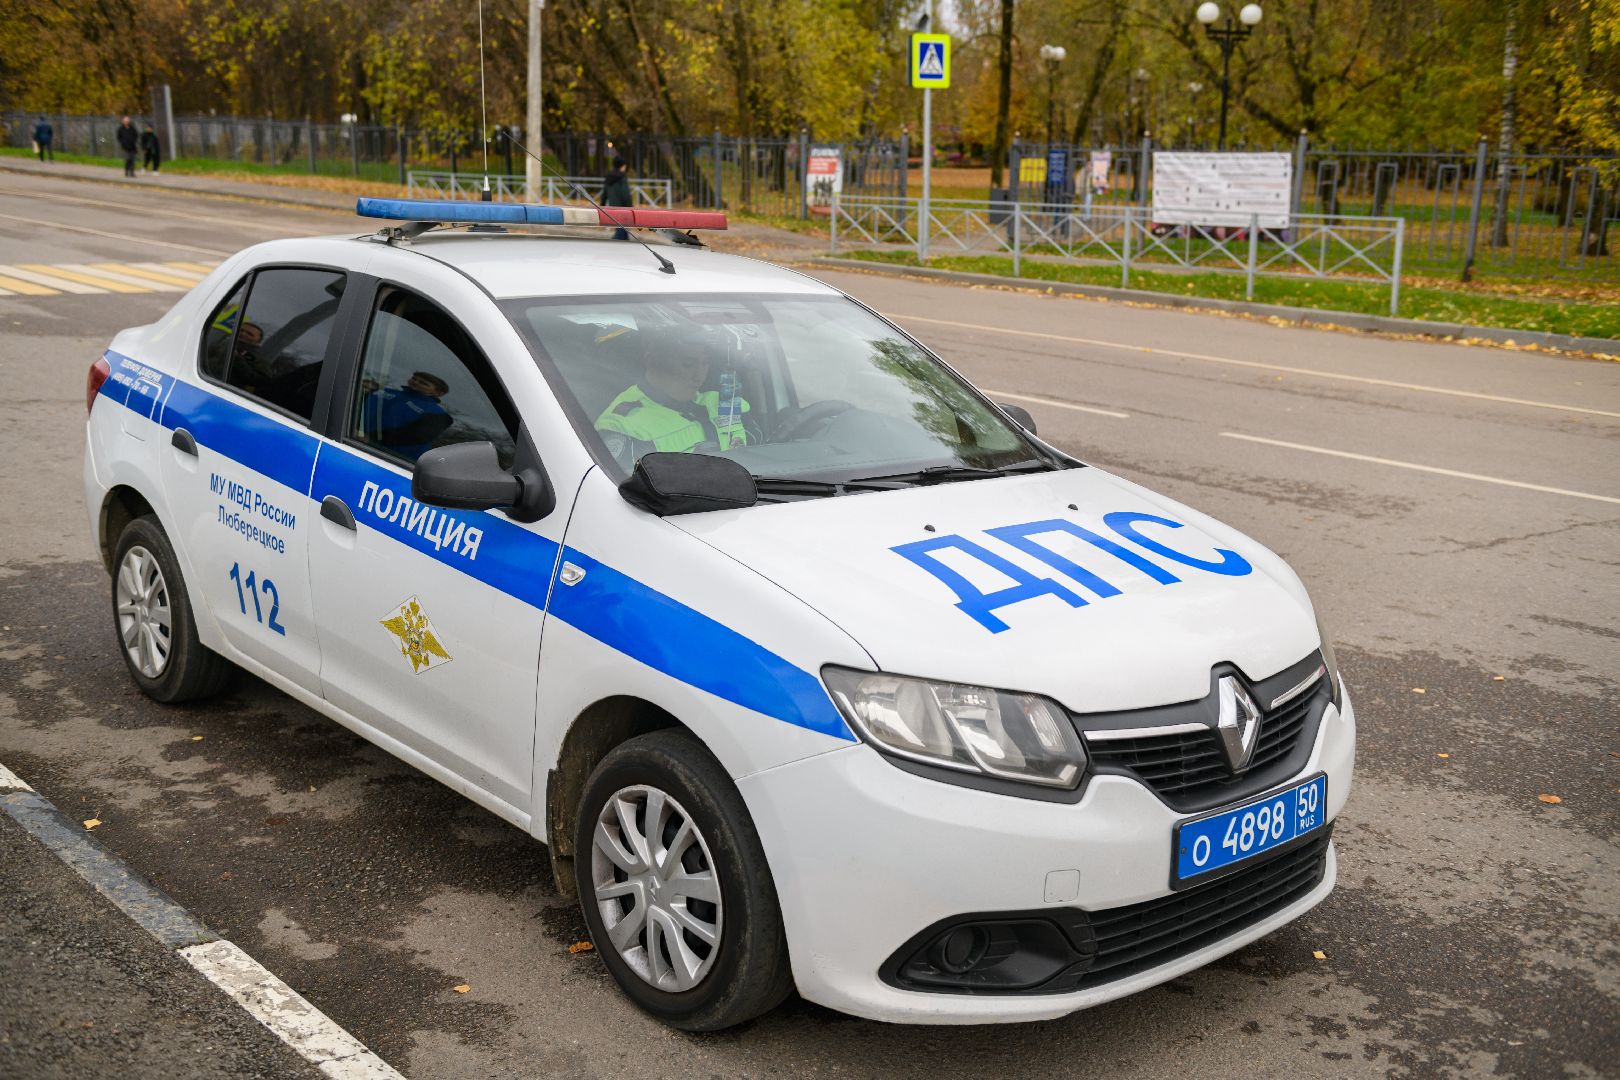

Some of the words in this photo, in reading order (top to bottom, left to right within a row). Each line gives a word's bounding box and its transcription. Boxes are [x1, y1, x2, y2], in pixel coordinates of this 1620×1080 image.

[210, 472, 226, 496] МУ
[227, 480, 252, 514] МВД
[254, 493, 296, 530] России
[218, 505, 285, 554] Люберецкое
[358, 480, 483, 560] ПОЛИЦИЯ
[229, 562, 286, 636] 112
[887, 511, 1253, 634] ДПС
[1222, 800, 1285, 856] 4898
[1298, 783, 1318, 817] 50
[1300, 815, 1315, 830] RUS
